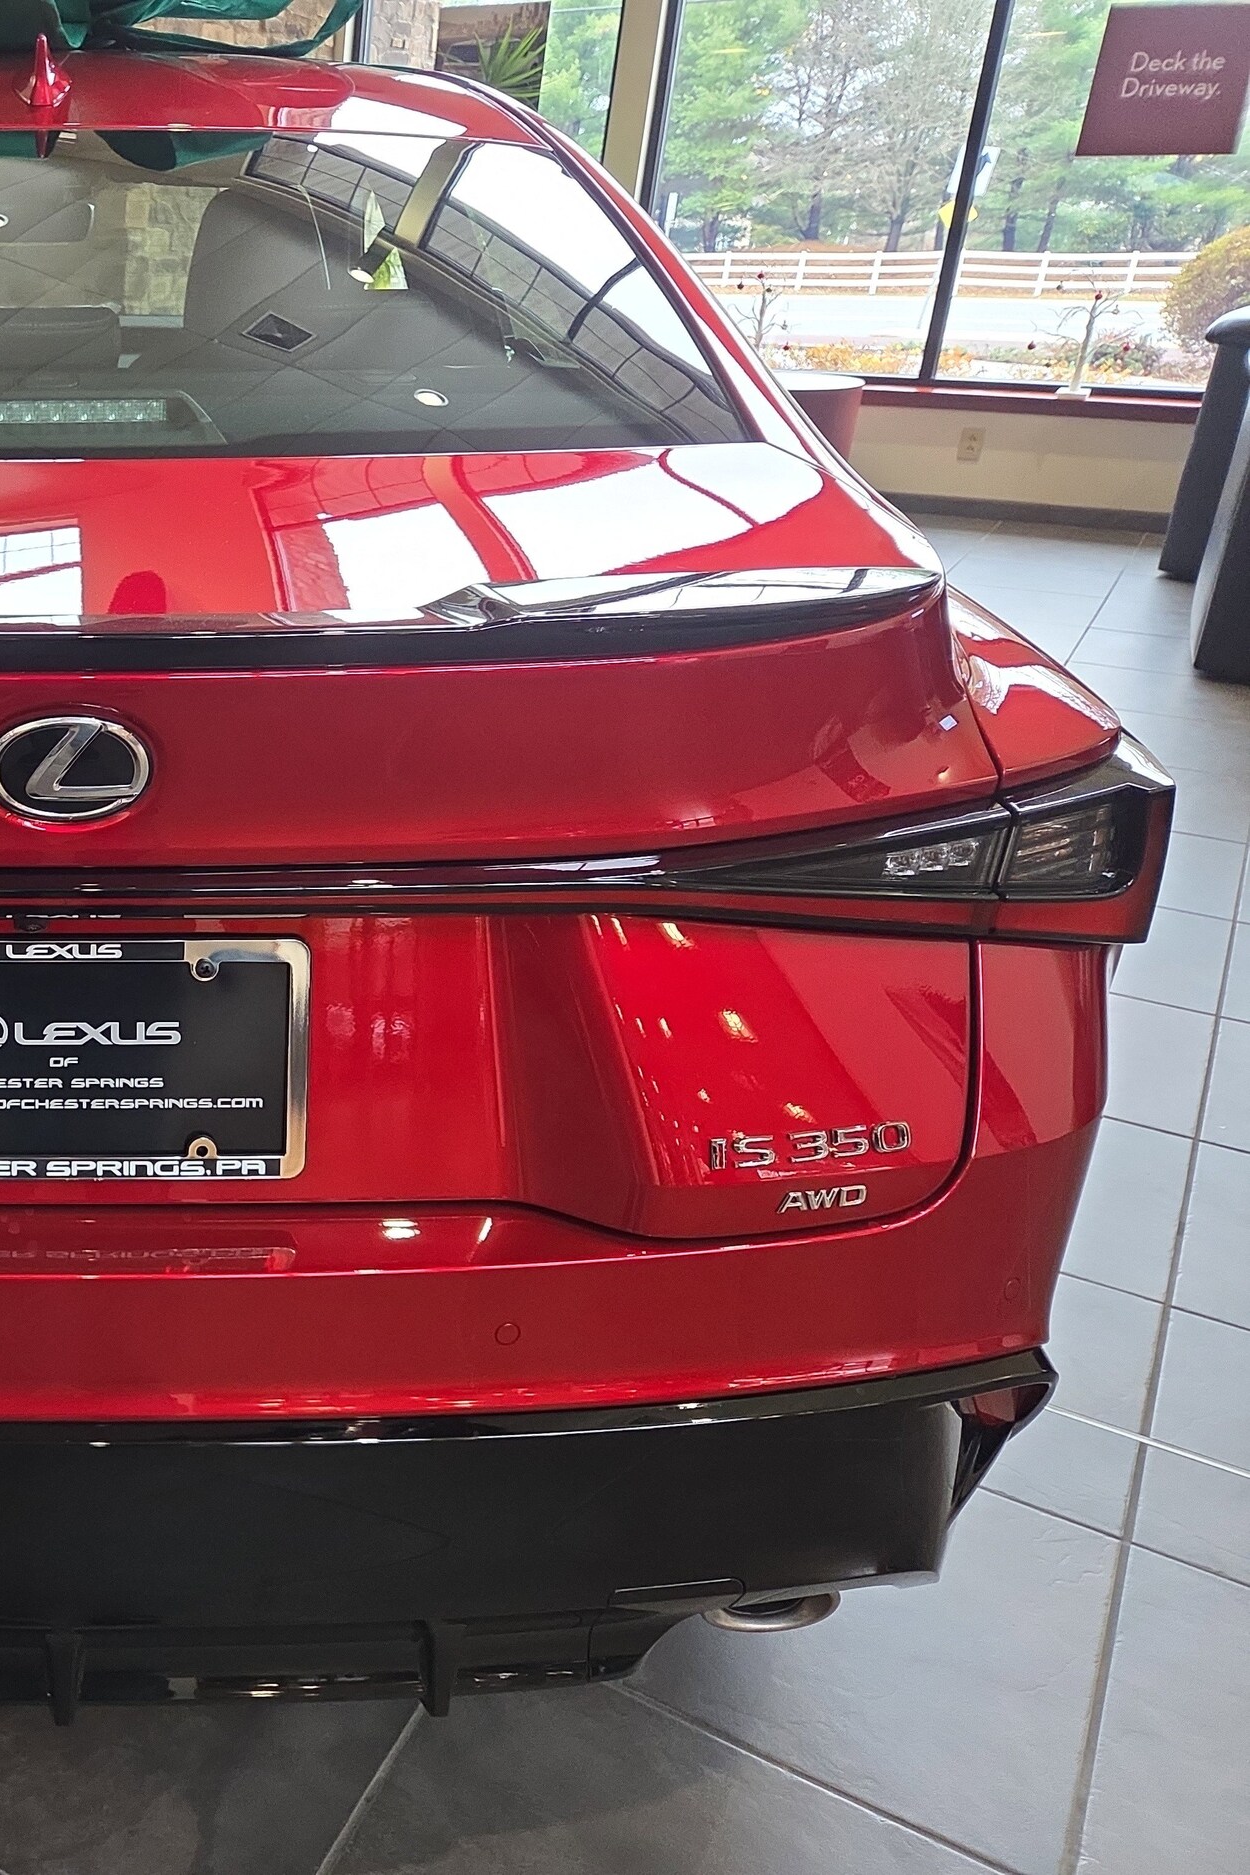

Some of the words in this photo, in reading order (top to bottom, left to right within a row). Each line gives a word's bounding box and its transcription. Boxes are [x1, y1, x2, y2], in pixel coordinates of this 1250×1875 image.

[1130, 50, 1186, 73] Deck
[1192, 50, 1227, 72] the
[1120, 77, 1222, 100] Driveway.
[5, 943, 123, 960] LEXUS
[14, 1021, 182, 1046] LEXUS
[49, 1057, 79, 1068] OF
[70, 1077, 165, 1089] SPRINGS
[710, 1134, 776, 1170] IS
[787, 1120, 912, 1163] 350
[776, 1184, 868, 1215] AWD
